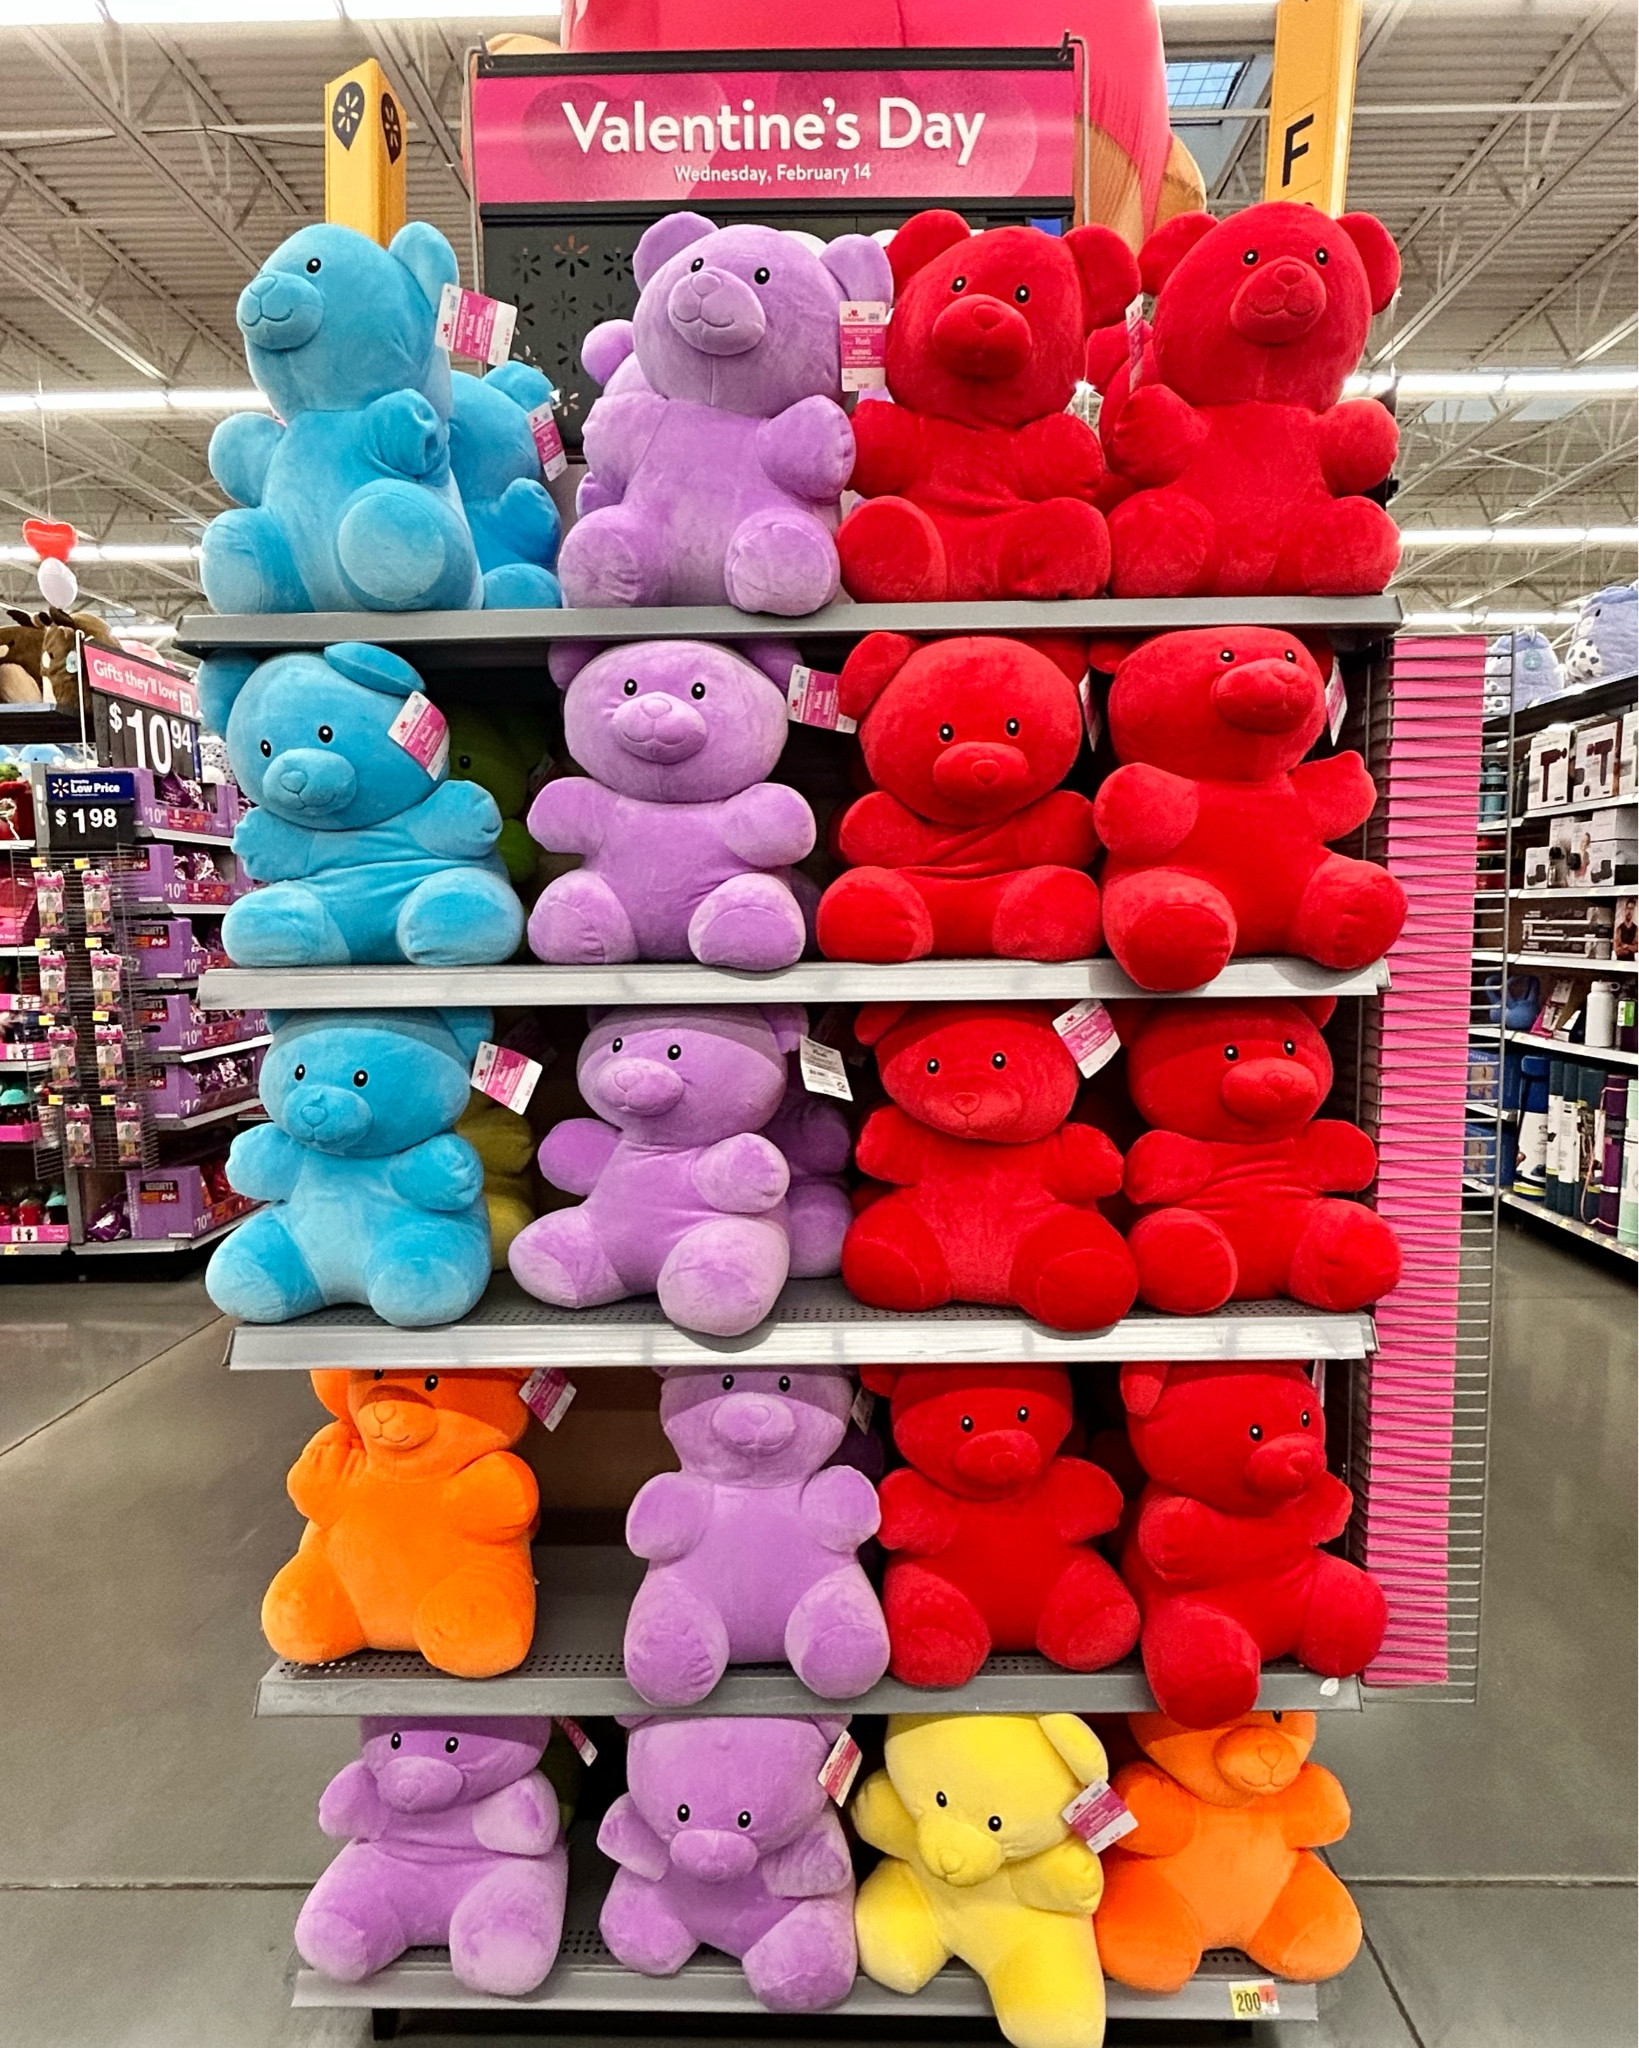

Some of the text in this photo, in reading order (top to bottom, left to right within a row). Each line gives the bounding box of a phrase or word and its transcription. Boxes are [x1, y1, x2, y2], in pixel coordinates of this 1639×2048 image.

[561, 97, 986, 166] Valentine's Day
[1281, 113, 1314, 187] F
[674, 162, 872, 186] Wednesday, February 14
[93, 659, 178, 701] Gifts they'll love
[71, 782, 120, 794] Low Price
[1236, 1991, 1262, 2012] 200
